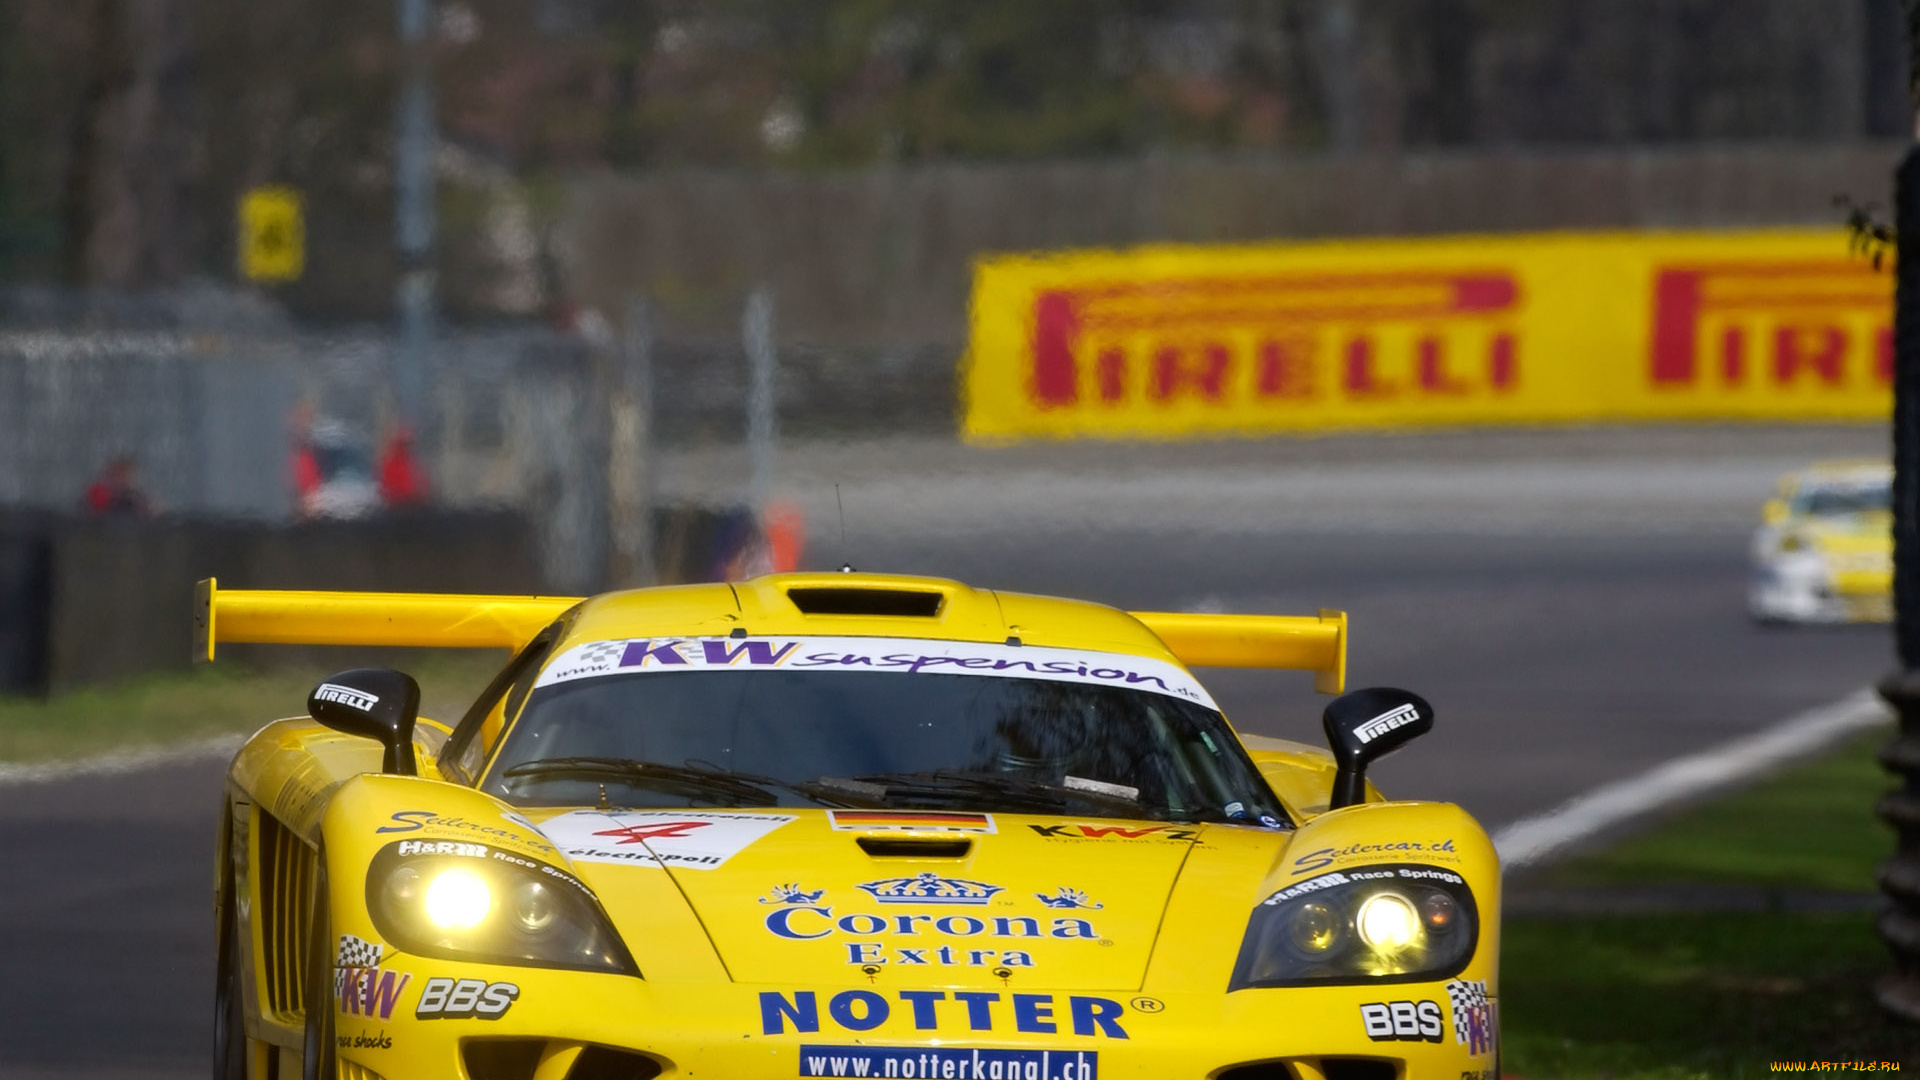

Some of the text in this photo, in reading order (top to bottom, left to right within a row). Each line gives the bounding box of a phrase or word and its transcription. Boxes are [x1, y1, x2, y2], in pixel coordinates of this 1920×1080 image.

[1031, 270, 1519, 406] PIRELLI
[618, 640, 803, 668] KW
[314, 683, 379, 712] PIRELLI
[1353, 703, 1420, 744] PIRELLI
[1027, 825, 1204, 845] KWZ
[493, 852, 537, 869] Race
[1291, 839, 1457, 876] Seilercar.ch
[1350, 870, 1395, 881] Race
[1399, 869, 1463, 884] Springs
[766, 906, 1099, 939] Corona
[844, 942, 1036, 967] Extra
[341, 964, 414, 1020] KW
[416, 977, 520, 1019] BBS
[758, 990, 1130, 1040] NOTTER
[1360, 1001, 1443, 1041] BBS
[353, 1029, 393, 1049] shocks
[808, 1049, 1091, 1080] www.notterkanal.ch
